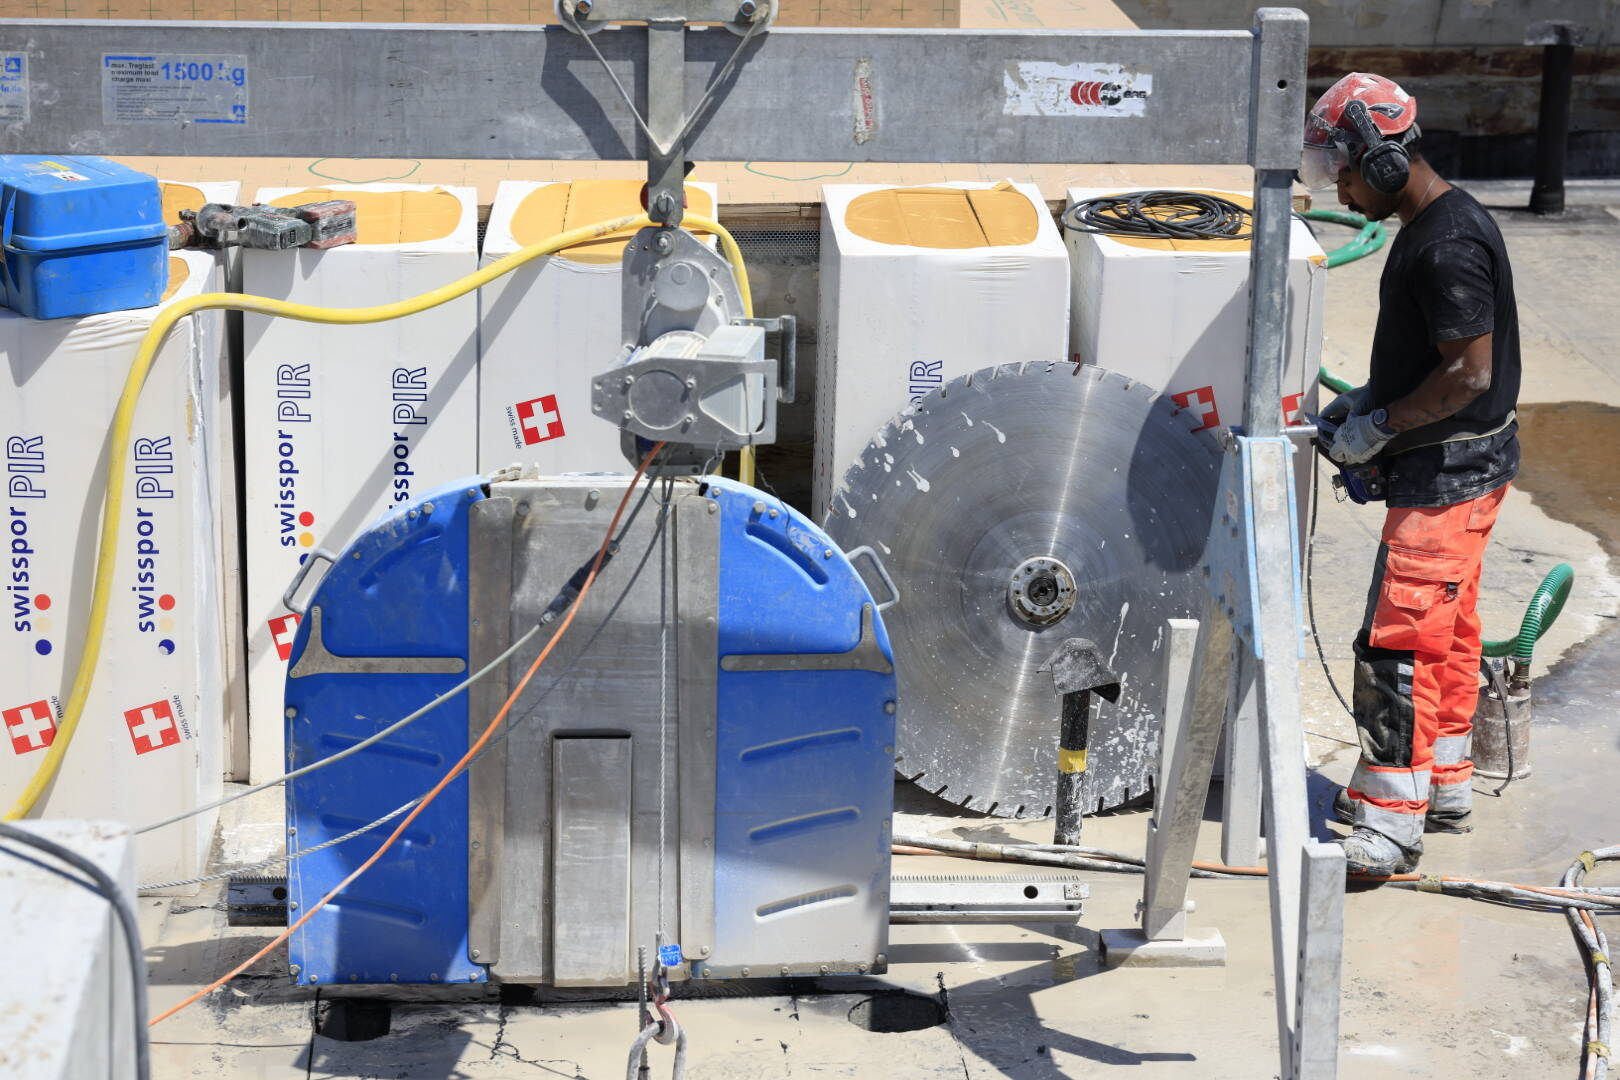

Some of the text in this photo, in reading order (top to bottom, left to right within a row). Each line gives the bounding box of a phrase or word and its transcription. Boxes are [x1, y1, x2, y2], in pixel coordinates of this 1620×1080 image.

[160, 61, 214, 81] 1500
[909, 360, 943, 404] IR
[275, 363, 312, 547] swisspor PIR
[389, 366, 428, 509] sspor PIR
[511, 427, 522, 449] made
[7, 435, 47, 632] swisspor PIR
[132, 435, 174, 632] swisspor PIR
[173, 694, 185, 718] made
